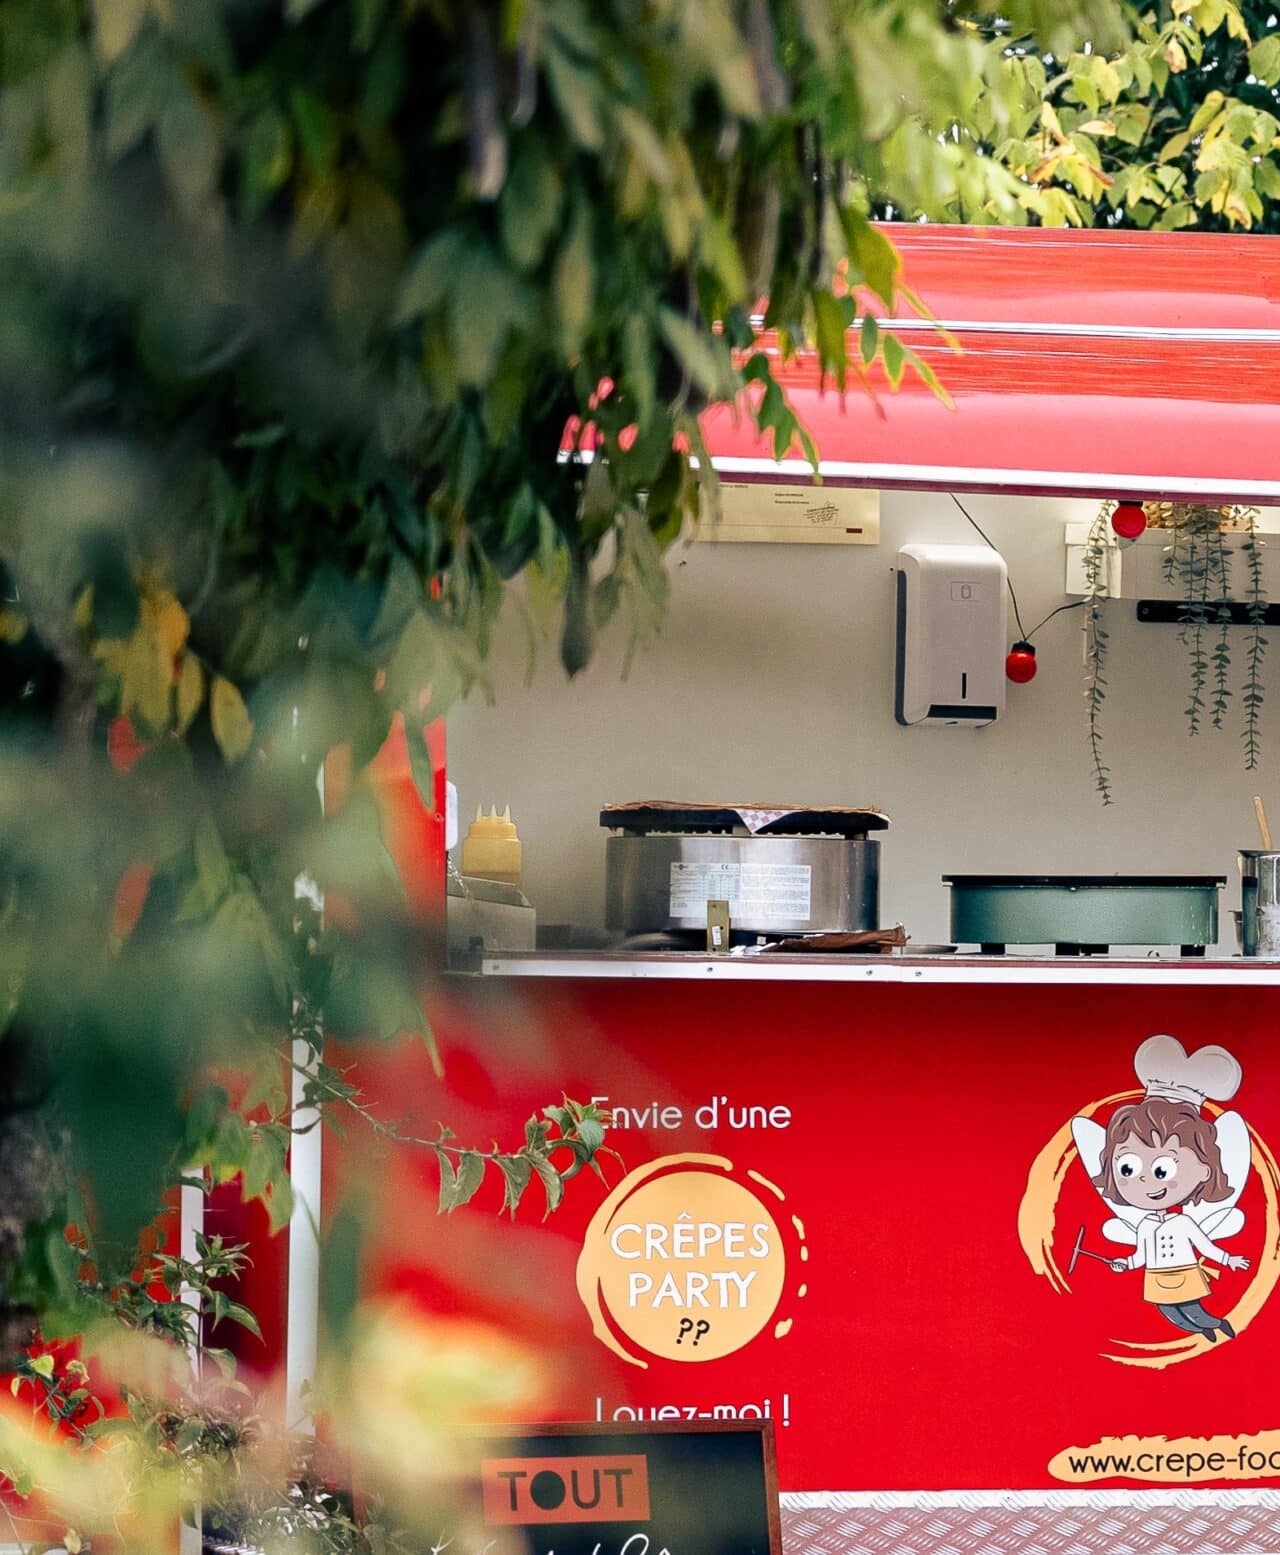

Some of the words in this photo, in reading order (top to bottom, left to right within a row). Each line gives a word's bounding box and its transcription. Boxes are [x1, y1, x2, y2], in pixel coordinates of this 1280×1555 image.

[695, 1096, 792, 1129] d'une
[610, 1210, 770, 1260] CRÊPES
[628, 1270, 757, 1309] PARTY
[676, 1317, 710, 1346] ??
[497, 1468, 633, 1512] TOUT
